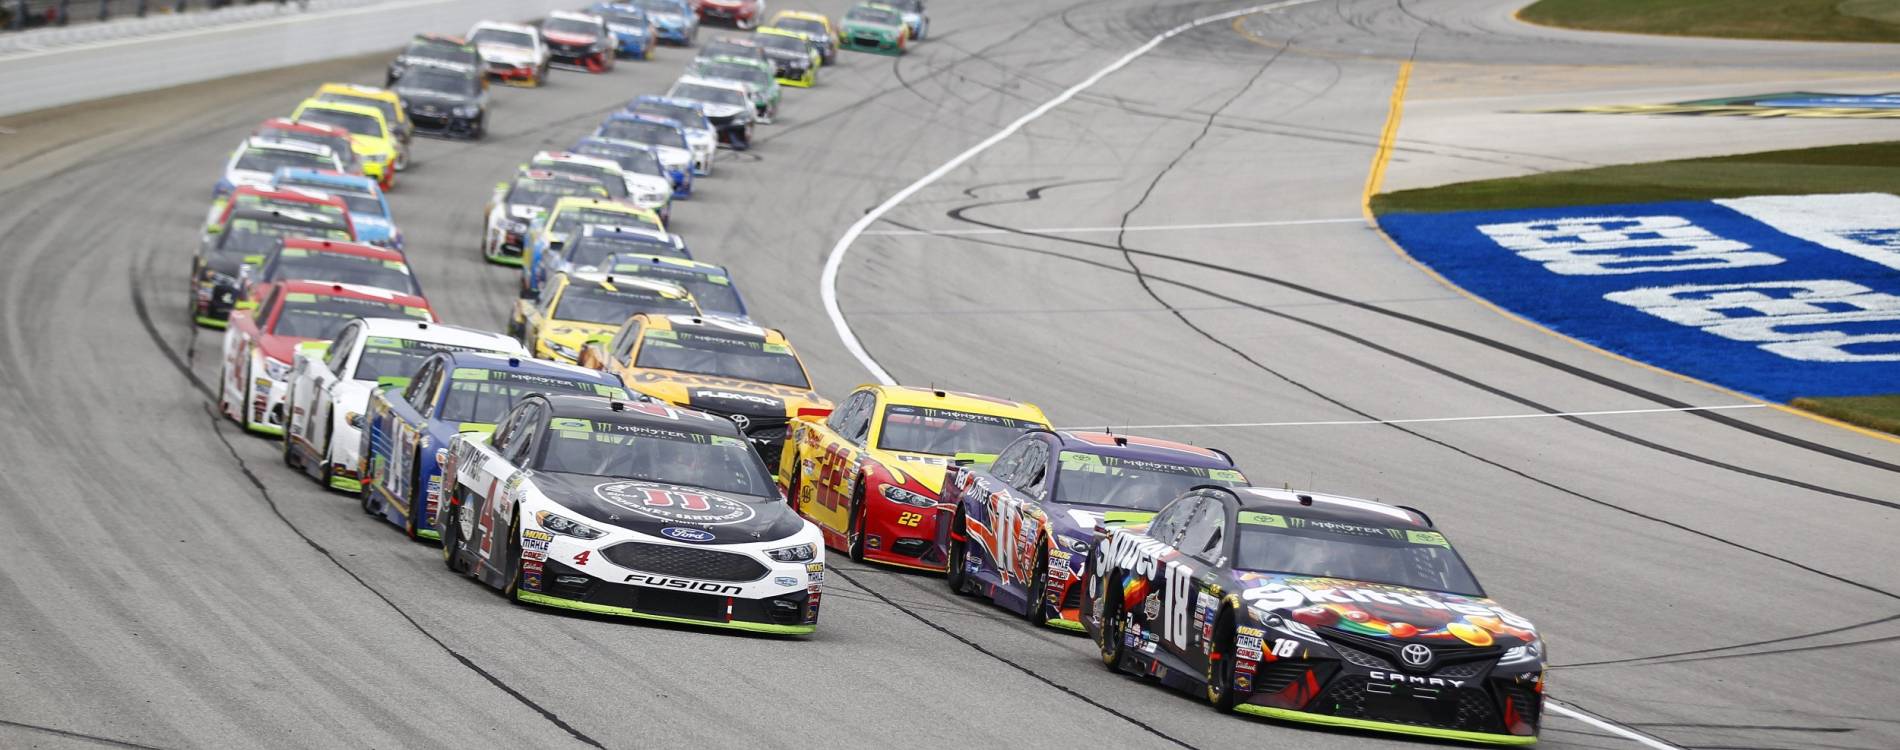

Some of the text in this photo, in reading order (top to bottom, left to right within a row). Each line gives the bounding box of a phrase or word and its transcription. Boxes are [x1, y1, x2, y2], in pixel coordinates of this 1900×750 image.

[511, 373, 575, 387] MONSTER
[696, 390, 780, 406] FLEXVOLT
[941, 410, 1001, 424] MONSTER
[617, 424, 687, 439] MONSTER
[1123, 459, 1188, 473] MONSTER
[478, 477, 499, 560] 4
[897, 512, 923, 527] 22
[671, 528, 704, 541] Ford
[1311, 520, 1384, 535] MONSTER
[525, 530, 552, 541] MOOG
[522, 539, 550, 551] MAHLE
[573, 550, 591, 566] 4
[1050, 548, 1073, 560] MOOG
[1049, 557, 1071, 570] MAHLE
[623, 574, 743, 596] FUSION
[1164, 560, 1194, 651] 18
[1242, 582, 1536, 630] Skittles
[1237, 626, 1267, 637] MOOG
[1238, 635, 1262, 649] MAHLE
[1271, 638, 1300, 658] 18
[1369, 670, 1465, 688] CAMRY
